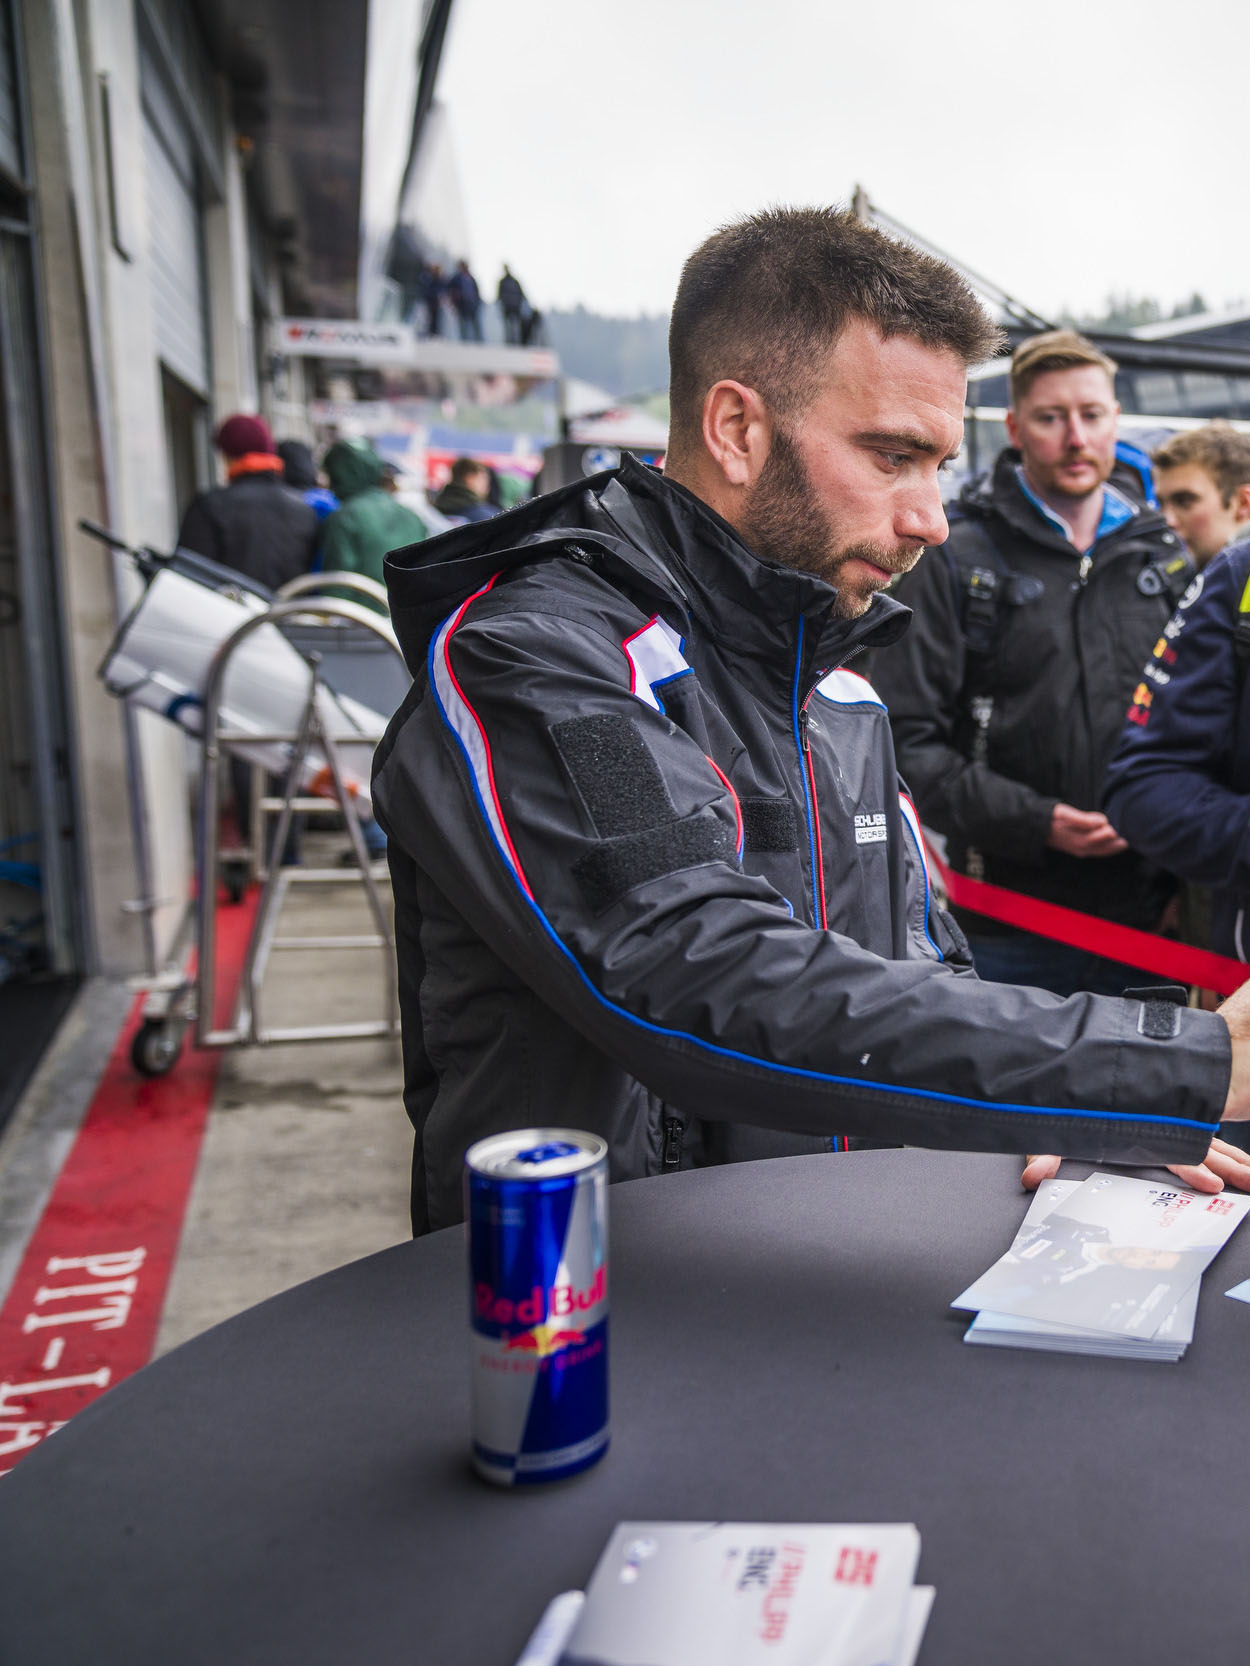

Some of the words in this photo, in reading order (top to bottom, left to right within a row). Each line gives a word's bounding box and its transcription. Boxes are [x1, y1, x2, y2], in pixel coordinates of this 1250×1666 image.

[854, 813, 886, 827] SCHUBE
[475, 1282, 544, 1324] Red
[549, 1262, 608, 1316] Bull
[0, 1246, 147, 1476] PIT-LA
